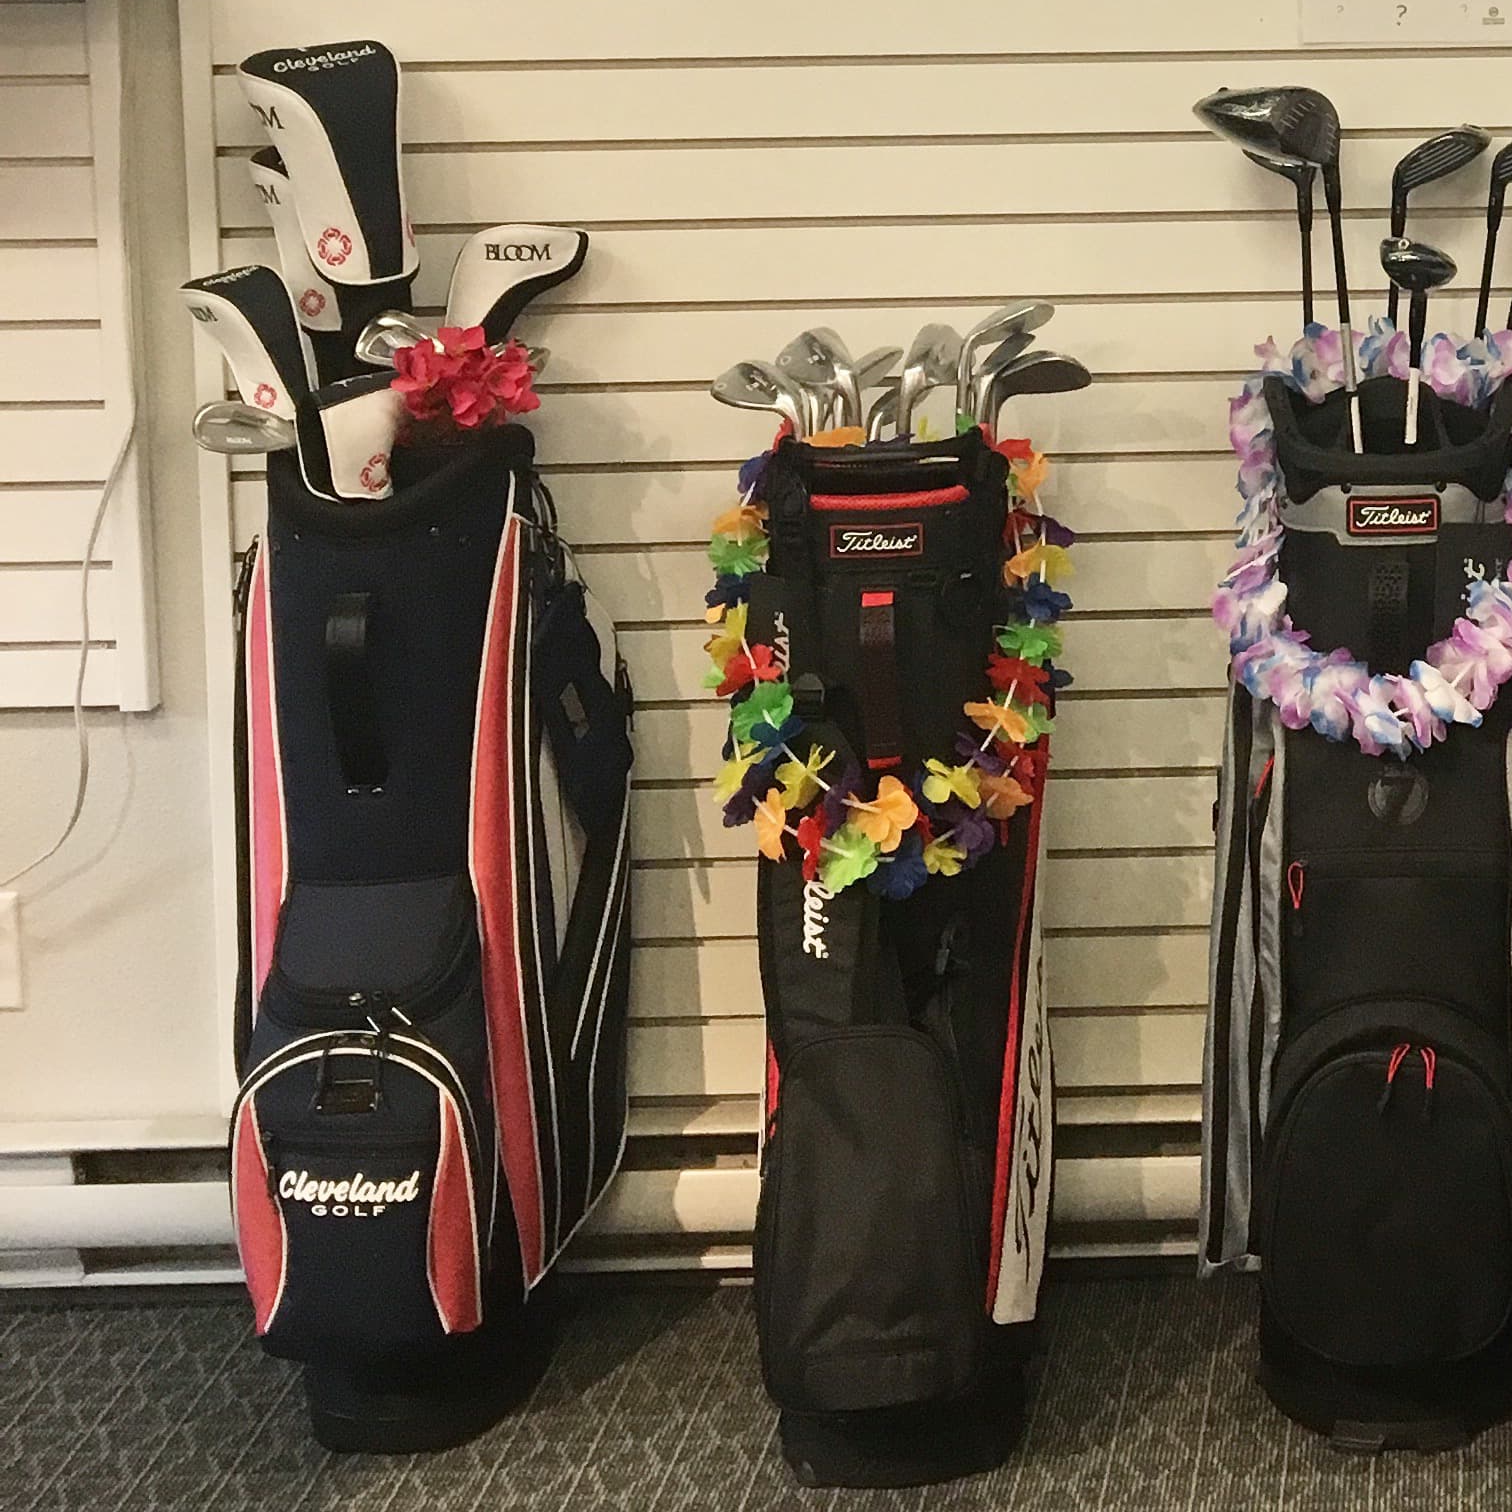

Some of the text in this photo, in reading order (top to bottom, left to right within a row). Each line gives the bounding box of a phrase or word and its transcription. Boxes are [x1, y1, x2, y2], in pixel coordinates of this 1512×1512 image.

[273, 45, 376, 73] Cleveland
[308, 57, 359, 71] GOLF
[484, 243, 552, 262] BLOOM
[1355, 504, 1430, 528] Titleist
[836, 531, 918, 553] Titleist
[1014, 953, 1042, 1285] Titleis
[279, 1170, 419, 1204] Cleveland
[311, 1205, 386, 1217] GOLF
